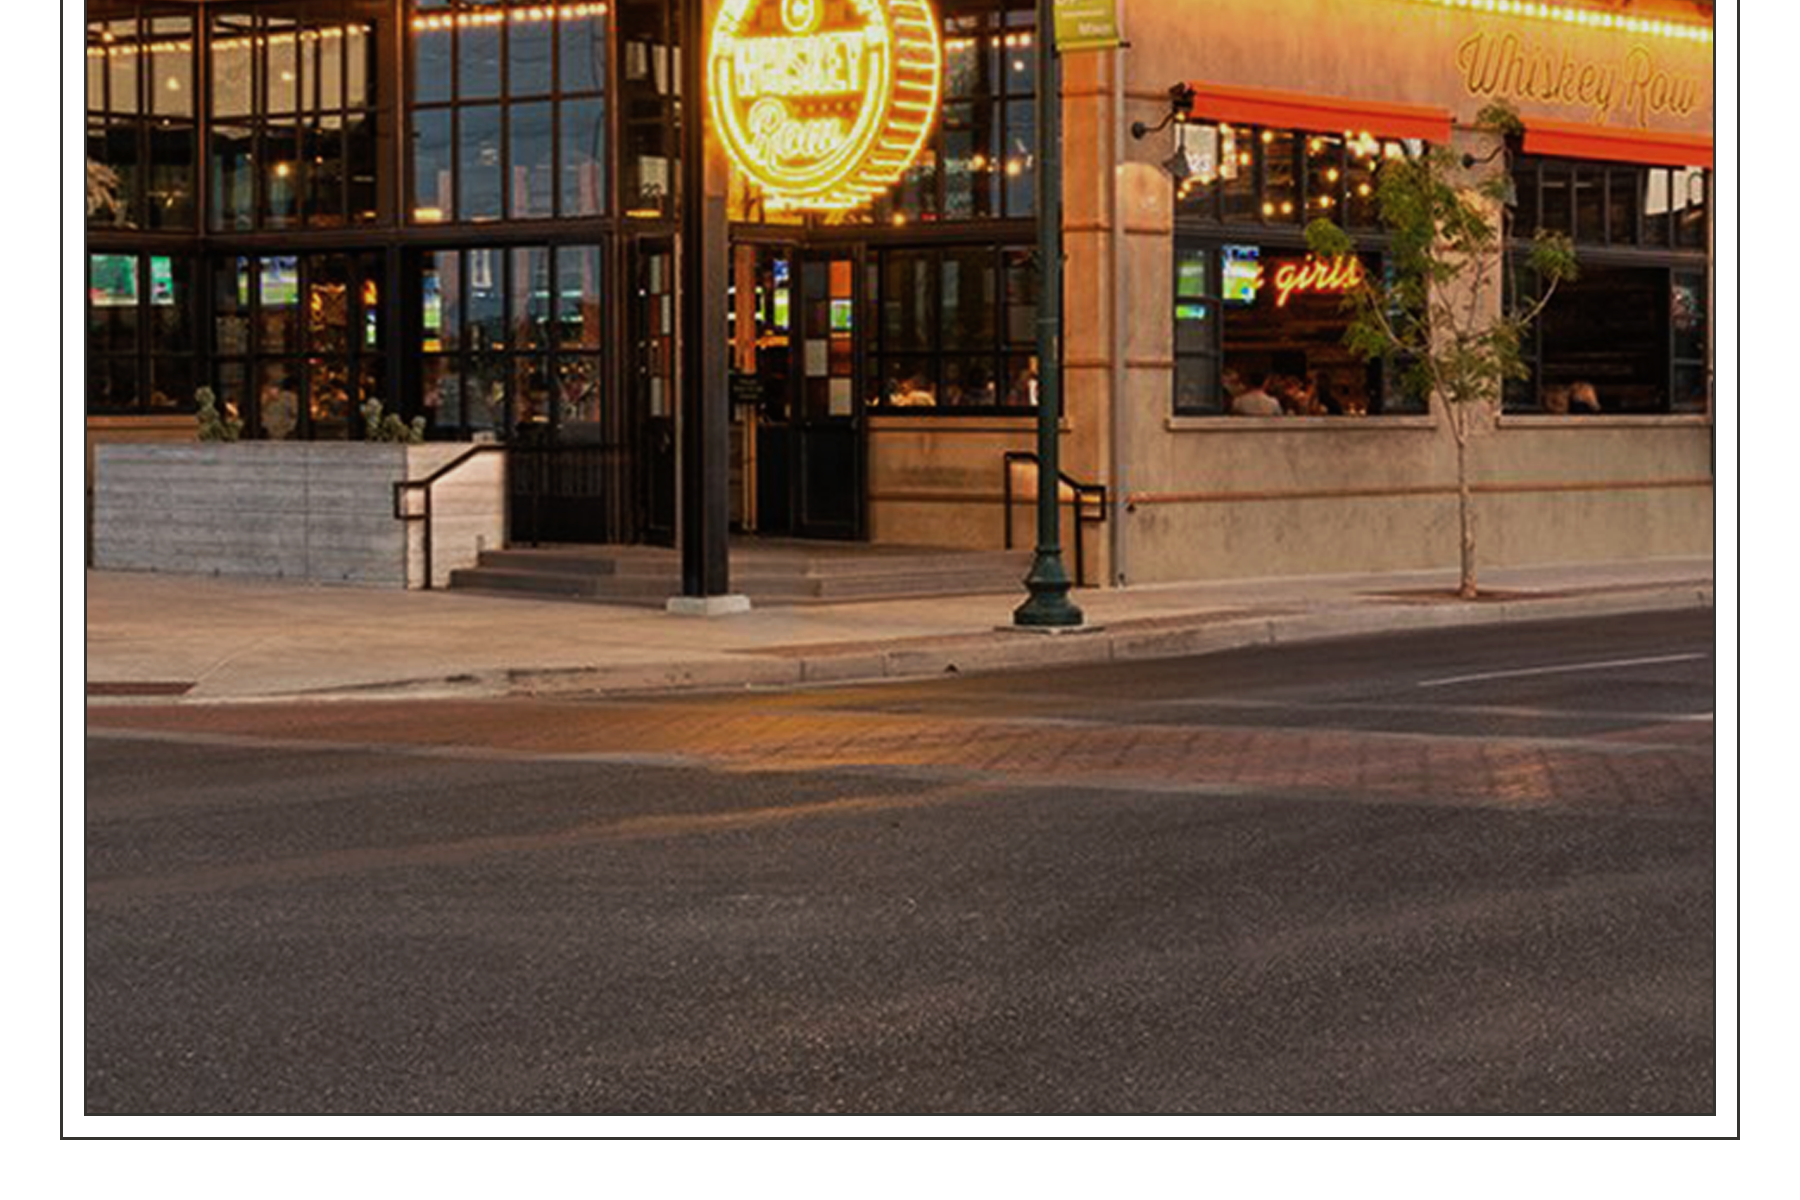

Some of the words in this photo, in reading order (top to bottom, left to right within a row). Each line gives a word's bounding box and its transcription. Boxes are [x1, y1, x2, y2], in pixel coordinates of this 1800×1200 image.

[1456, 31, 1617, 125] Whiskey
[1625, 43, 1698, 128] Row
[1275, 254, 1365, 307] girls
